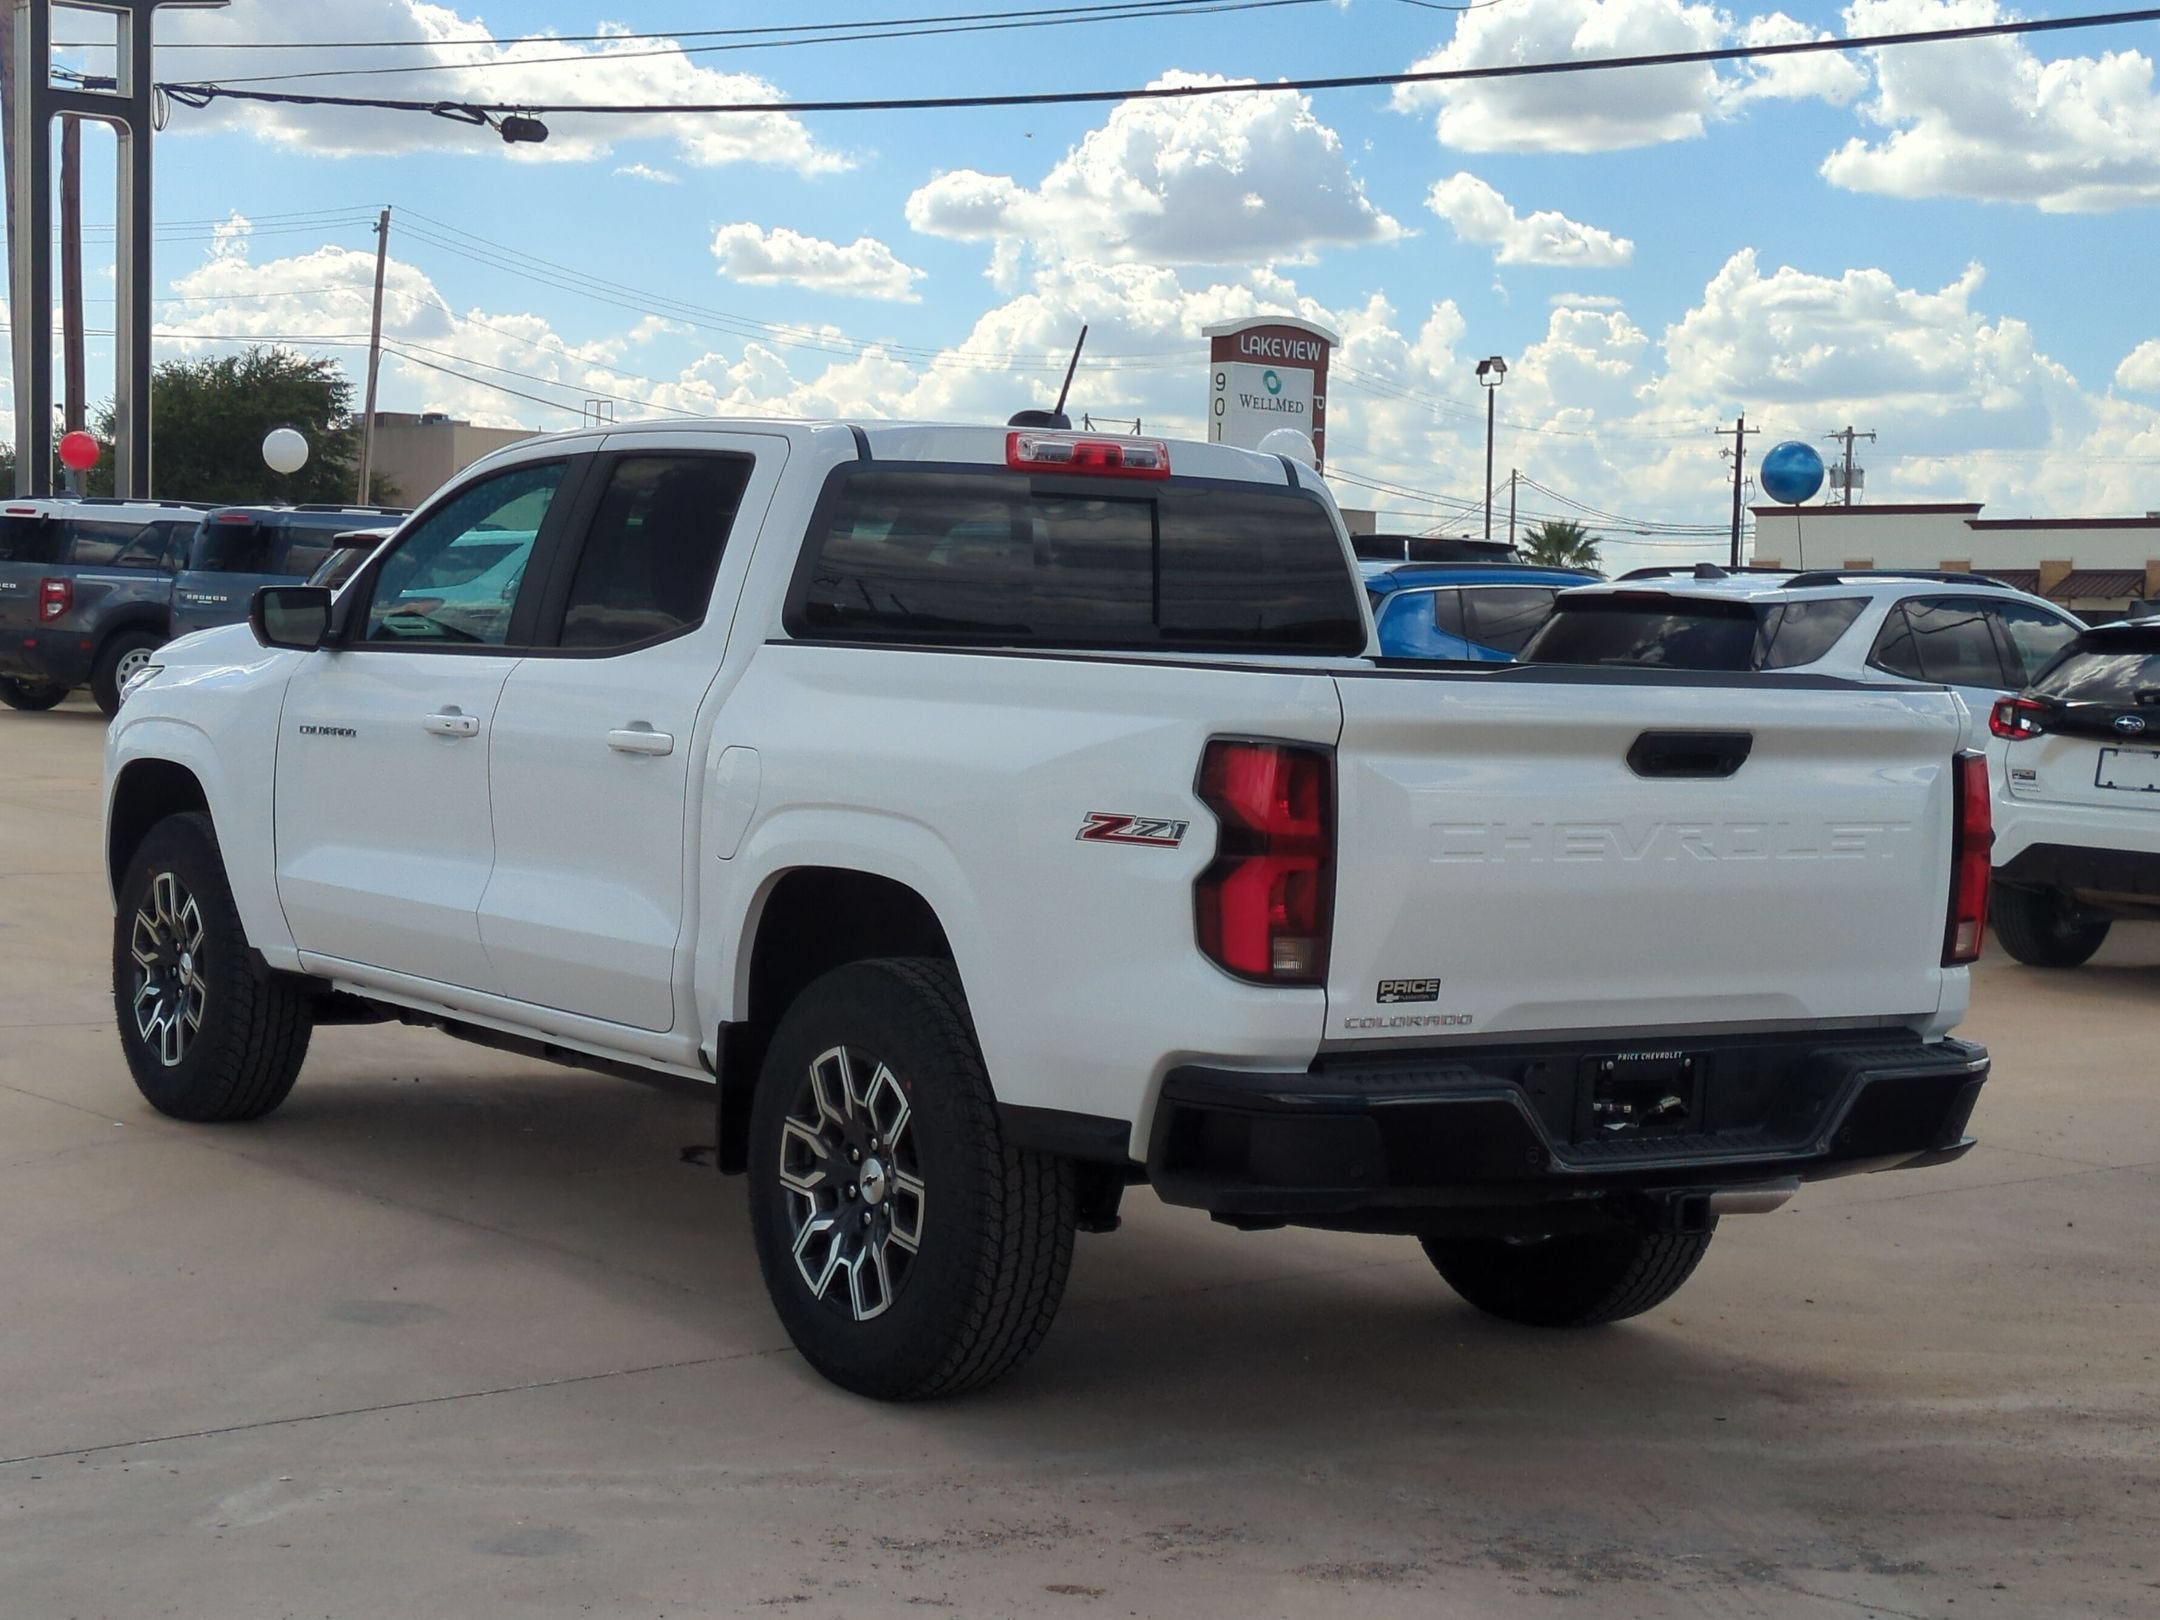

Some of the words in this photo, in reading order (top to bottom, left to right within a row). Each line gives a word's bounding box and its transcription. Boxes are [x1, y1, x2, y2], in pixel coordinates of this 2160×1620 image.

[1240, 335, 1321, 361] LAKEVIEW
[1214, 372, 1226, 441] 901
[1076, 811, 1190, 849] Z71
[1429, 821, 1911, 862] CHEVROLET
[1380, 980, 1438, 994] PRICE
[1344, 1014, 1473, 1029] COLORADO
[1617, 1053, 1639, 1061] PRICE
[1640, 1051, 1683, 1061] CHEVROLET
